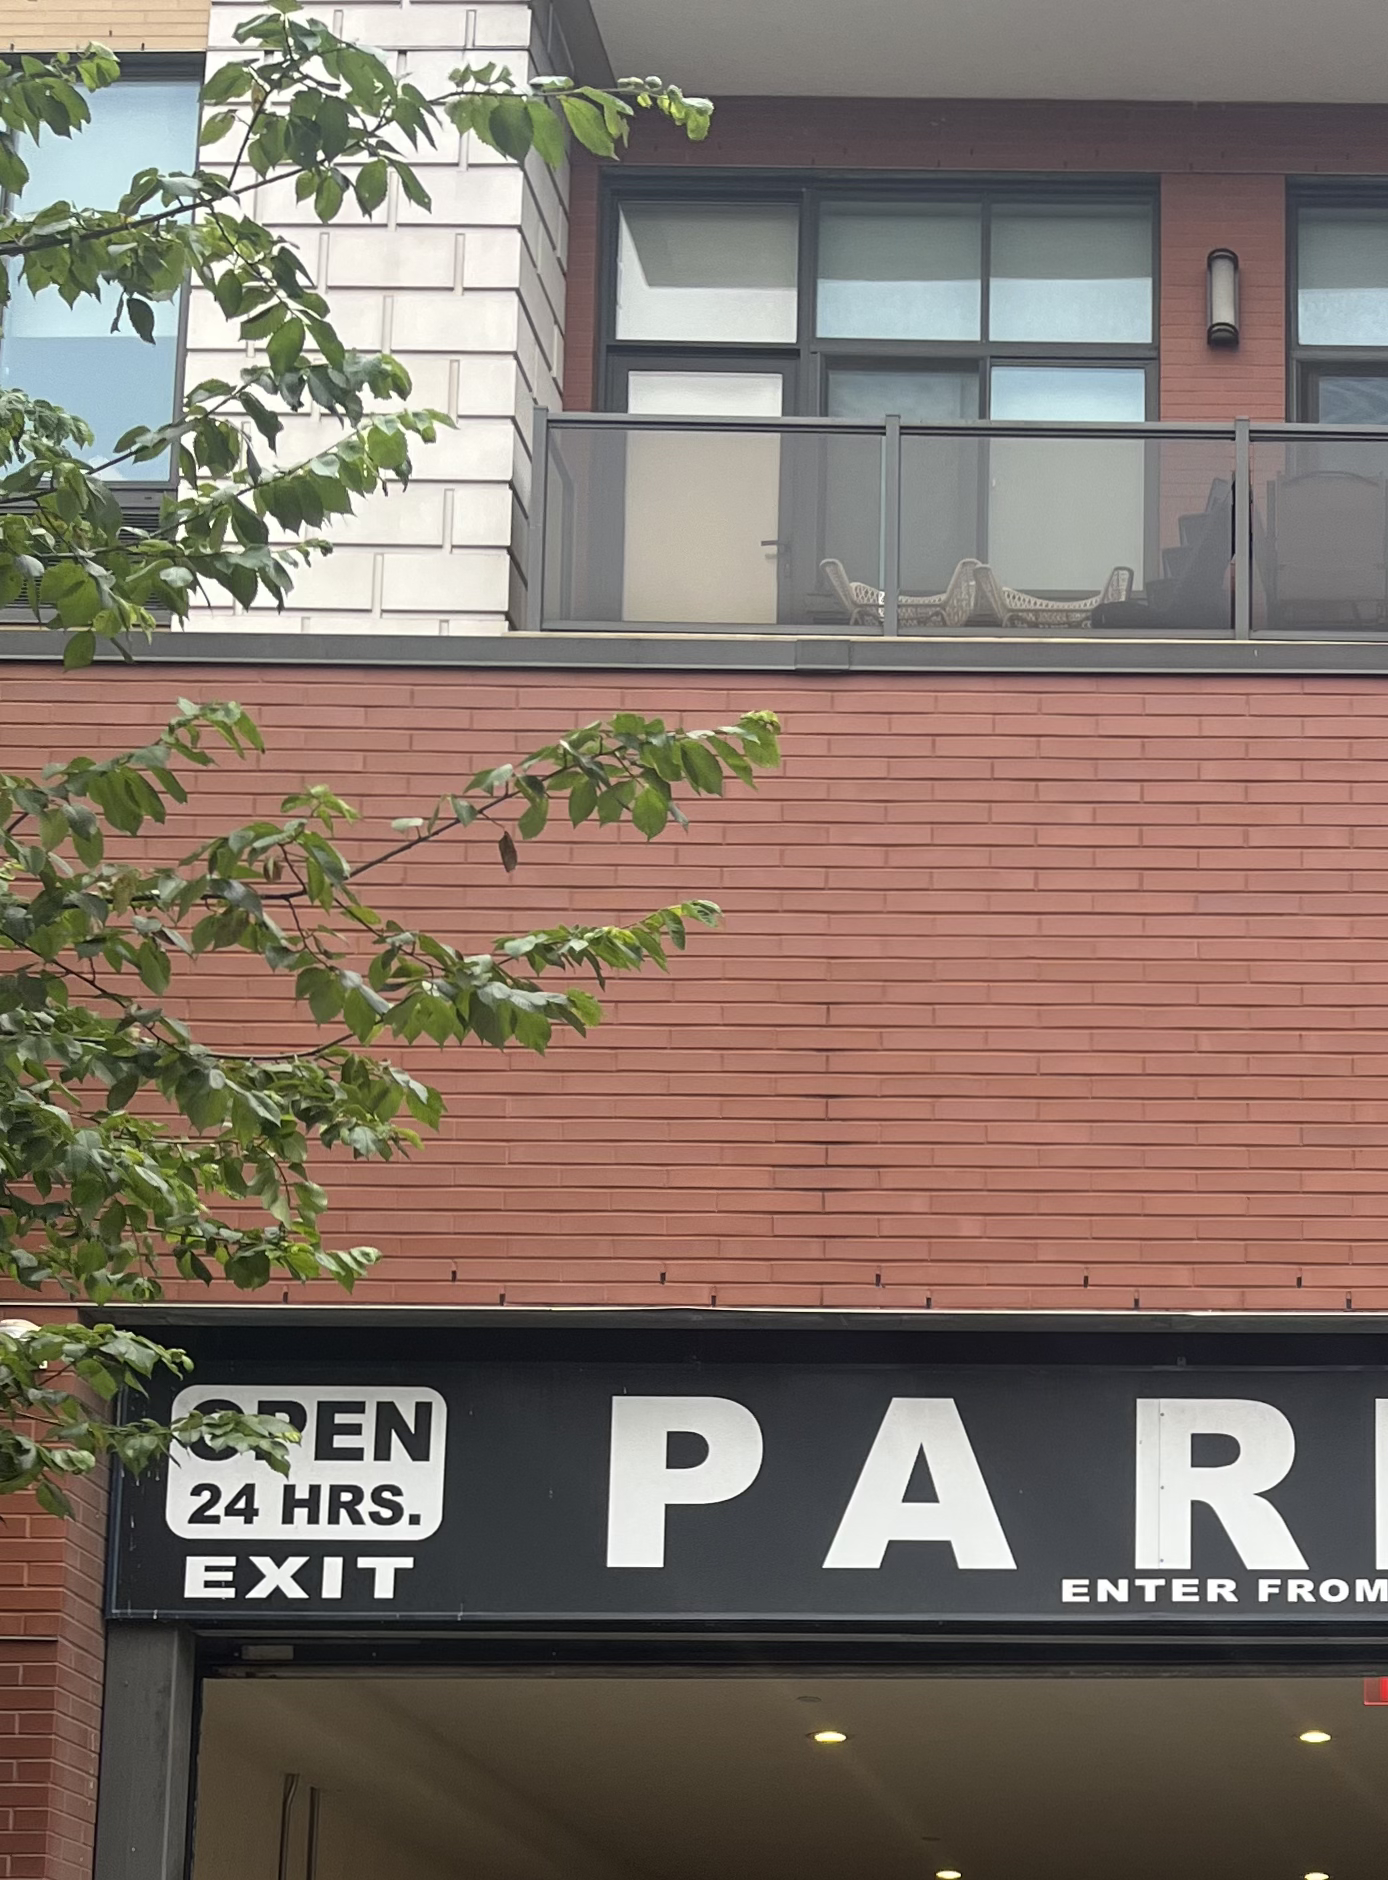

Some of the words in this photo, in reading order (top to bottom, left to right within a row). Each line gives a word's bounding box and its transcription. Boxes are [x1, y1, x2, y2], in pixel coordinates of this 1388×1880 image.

[187, 1483, 261, 1525] 24
[281, 1483, 422, 1526] HRS.
[184, 1556, 415, 1600] EXIT
[1061, 1578, 1240, 1604] ENTER
